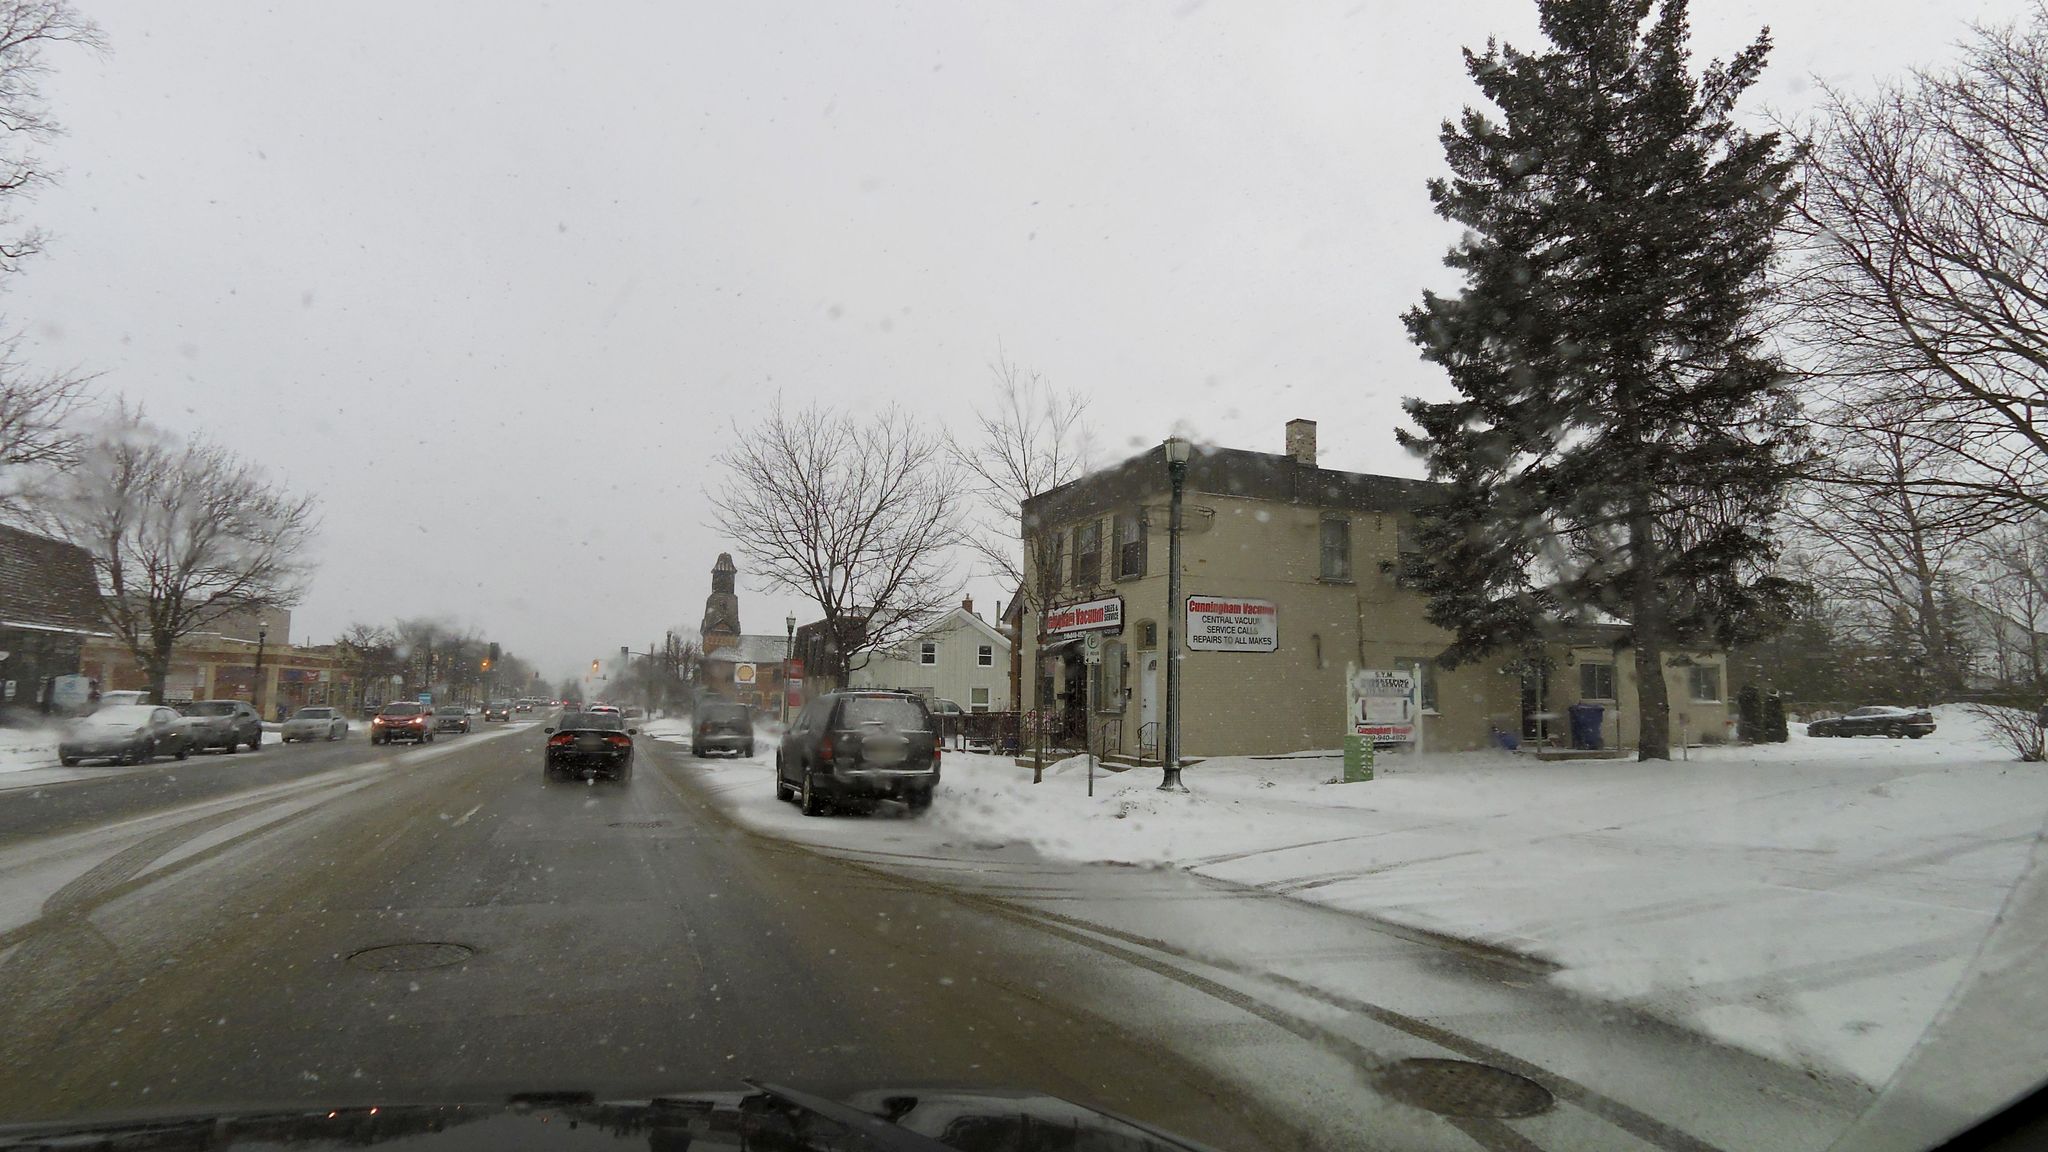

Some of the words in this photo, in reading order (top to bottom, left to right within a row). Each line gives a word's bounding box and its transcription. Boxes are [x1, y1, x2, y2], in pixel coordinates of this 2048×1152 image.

[1189, 600, 1241, 614] Cunningham
[1243, 602, 1274, 615] Vacuum
[1076, 607, 1104, 625] Vacuum
[1202, 615, 1233, 624] CENTRAL
[1206, 626, 1235, 634] SERVICE
[1237, 626, 1258, 635] CALLS
[1193, 635, 1222, 644] REPAIRS
[1224, 636, 1232, 644] TO
[1234, 637, 1247, 645] ALL
[1249, 637, 1272, 645] MAKES
